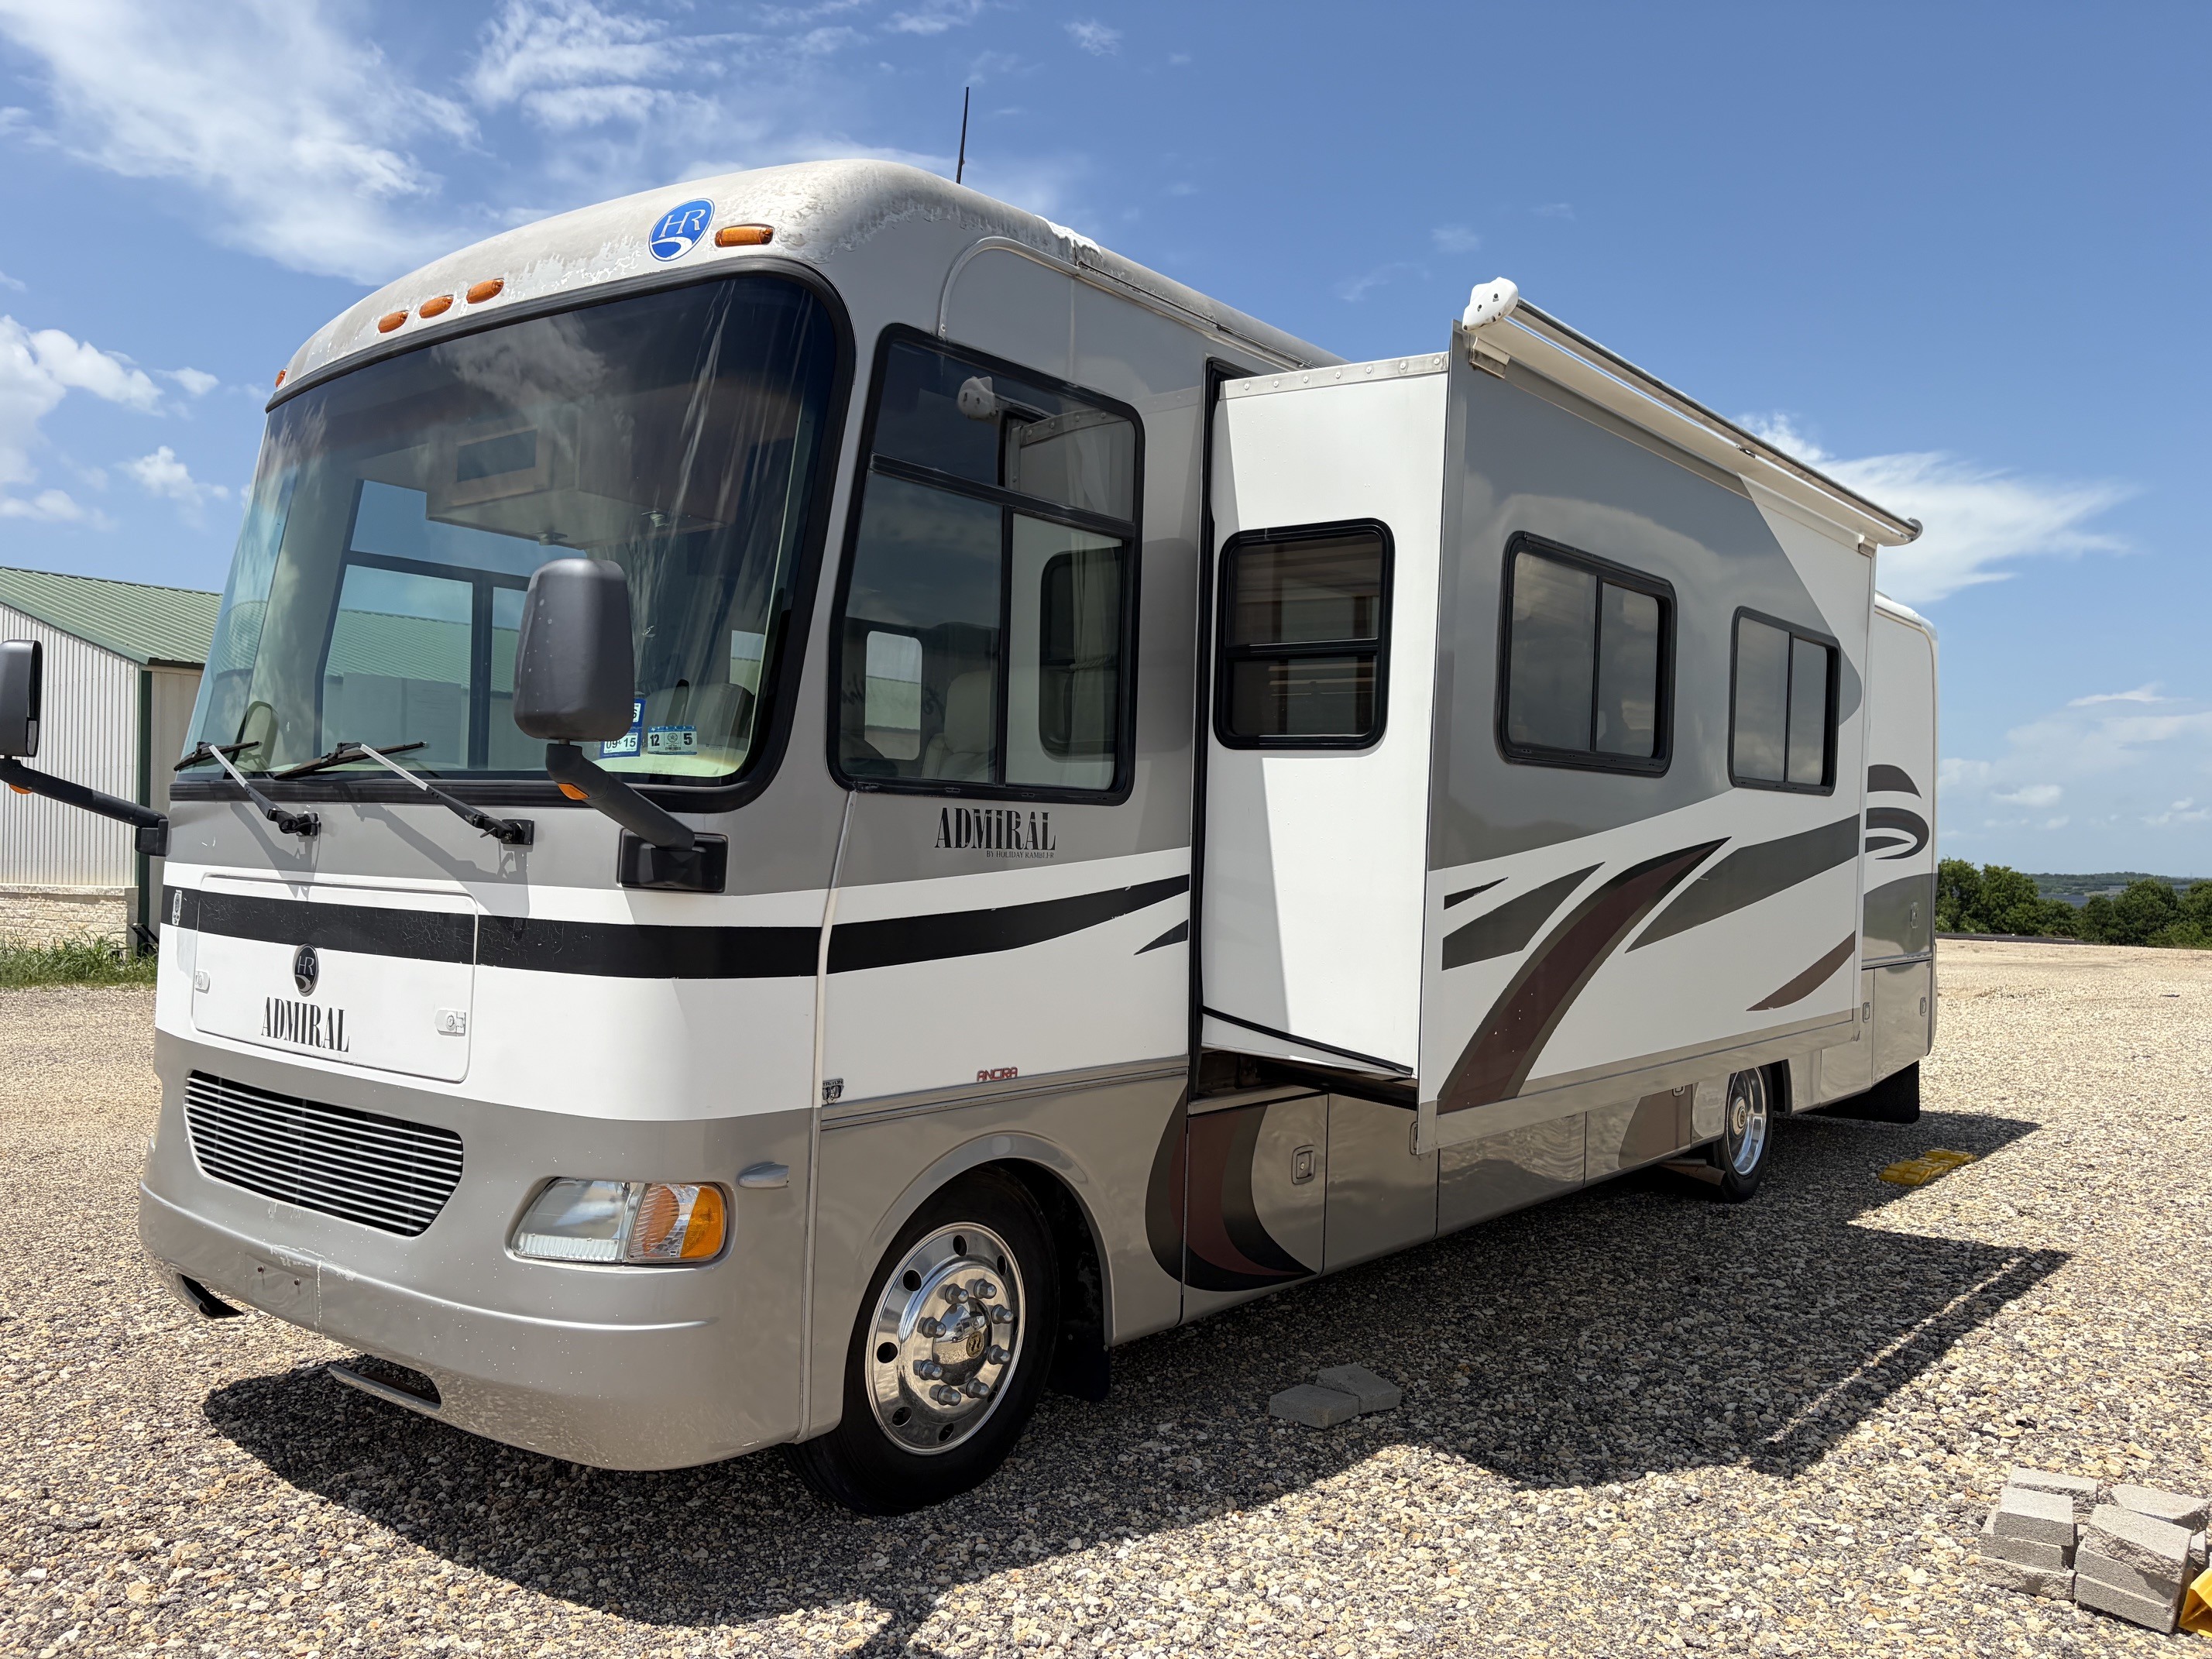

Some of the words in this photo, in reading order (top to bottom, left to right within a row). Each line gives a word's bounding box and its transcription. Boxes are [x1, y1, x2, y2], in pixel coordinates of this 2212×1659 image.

[658, 209, 706, 238] HR
[623, 737, 636, 748] 15
[650, 733, 660, 747] 12
[683, 733, 693, 746] 5
[934, 807, 1056, 850] ADMIRAL
[297, 956, 314, 975] HR
[261, 997, 349, 1053] ADMIRAL
[977, 1066, 1018, 1082] ANCIRA
